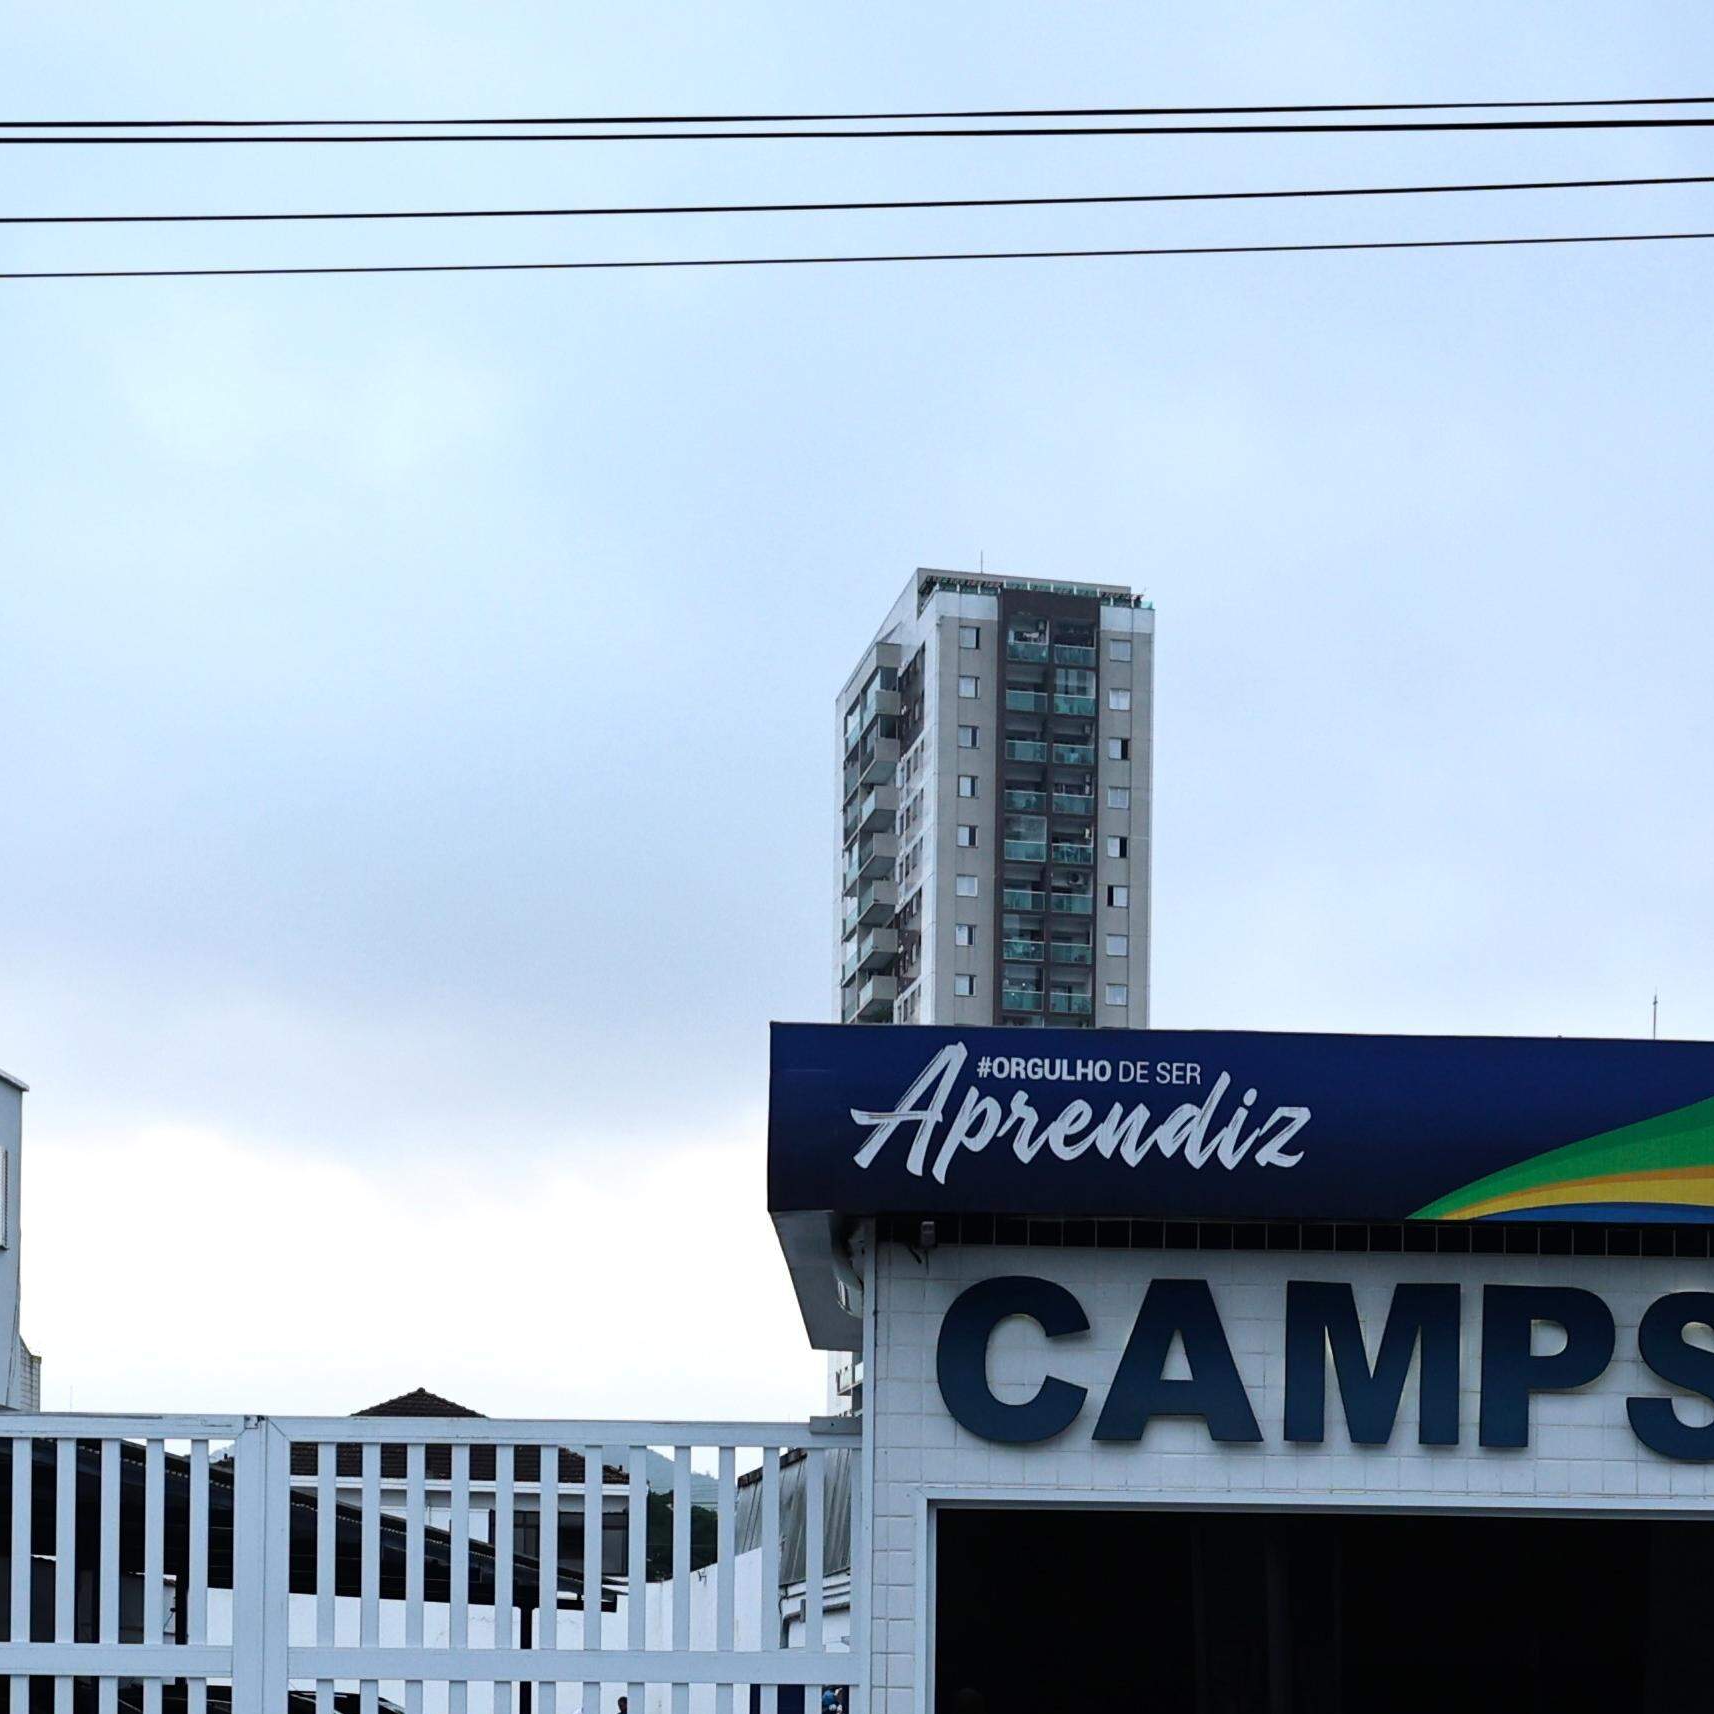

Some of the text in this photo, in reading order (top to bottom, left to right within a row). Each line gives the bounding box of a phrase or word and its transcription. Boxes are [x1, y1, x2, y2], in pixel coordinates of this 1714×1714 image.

[850, 1041, 1312, 1185] Aprendiz
[976, 1055, 1203, 1086] #ORGULHO DE SER
